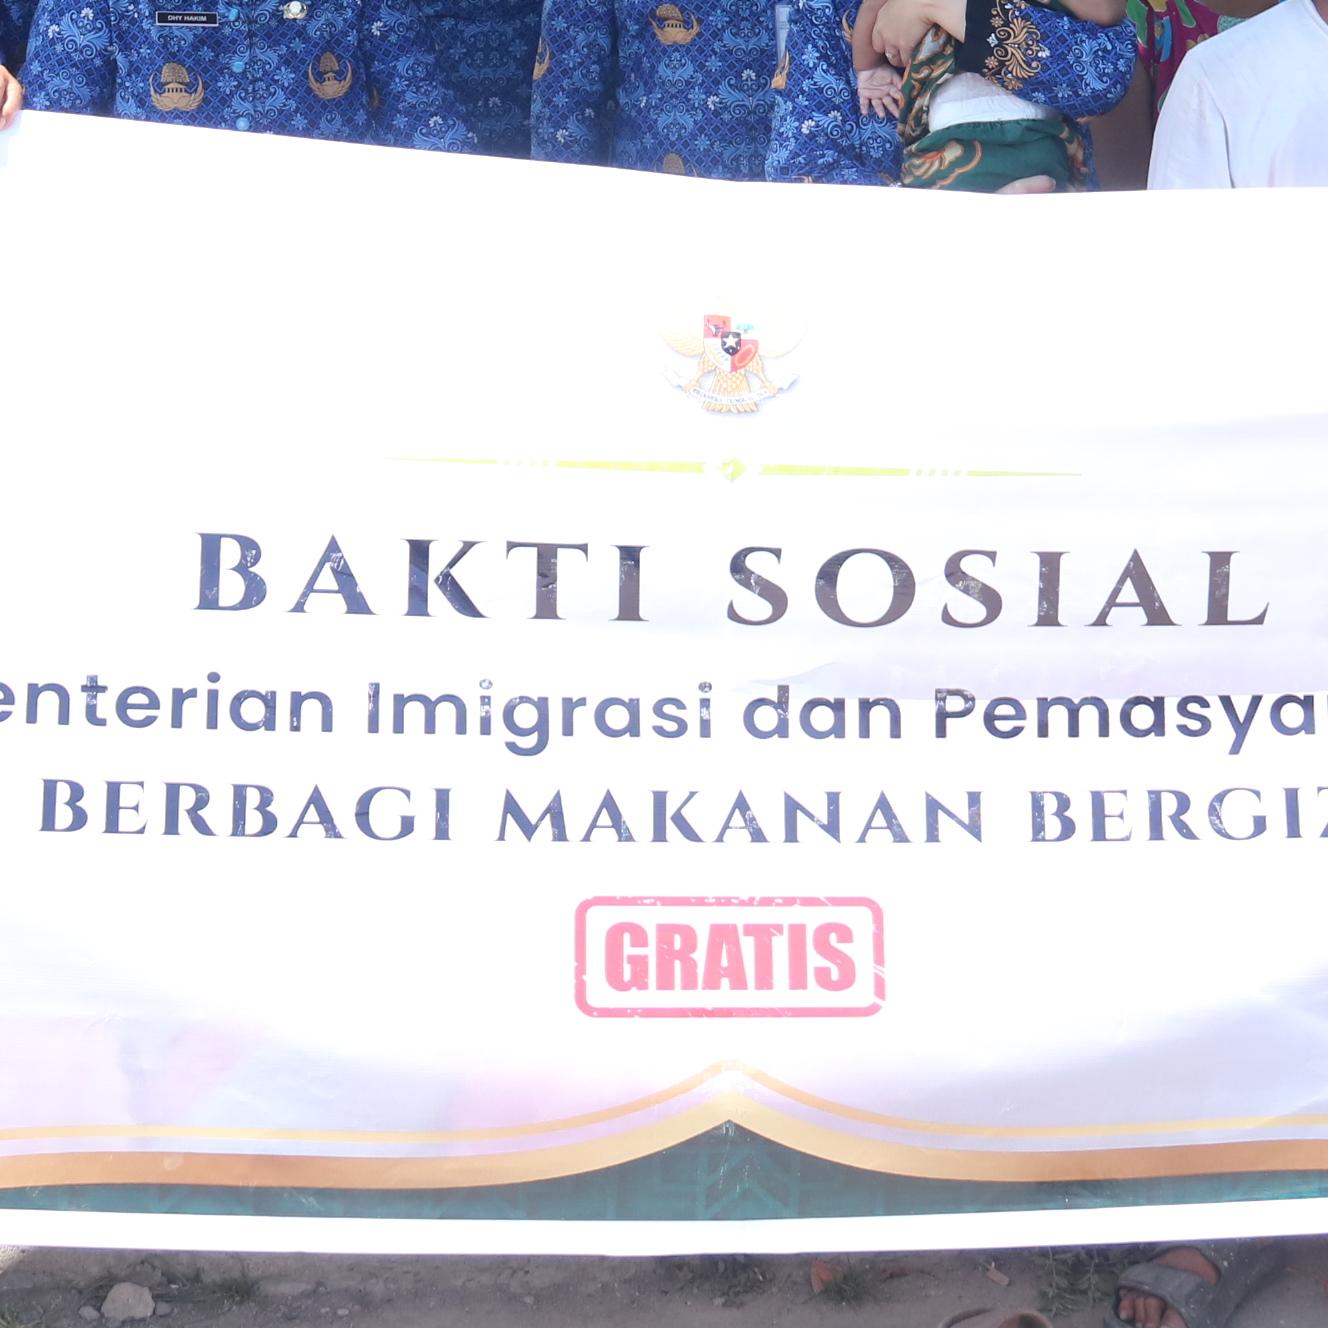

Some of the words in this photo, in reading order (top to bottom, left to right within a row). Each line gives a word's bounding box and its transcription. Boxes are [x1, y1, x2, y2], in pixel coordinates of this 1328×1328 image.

[194, 533, 649, 621] BAKTI
[727, 547, 1270, 628] SOSIAL
[367, 681, 712, 757] Imigrasi
[743, 684, 902, 739] dan
[39, 779, 452, 841] BERBAGI
[495, 789, 983, 843] MAKANAN
[605, 921, 856, 992] GRATIS
